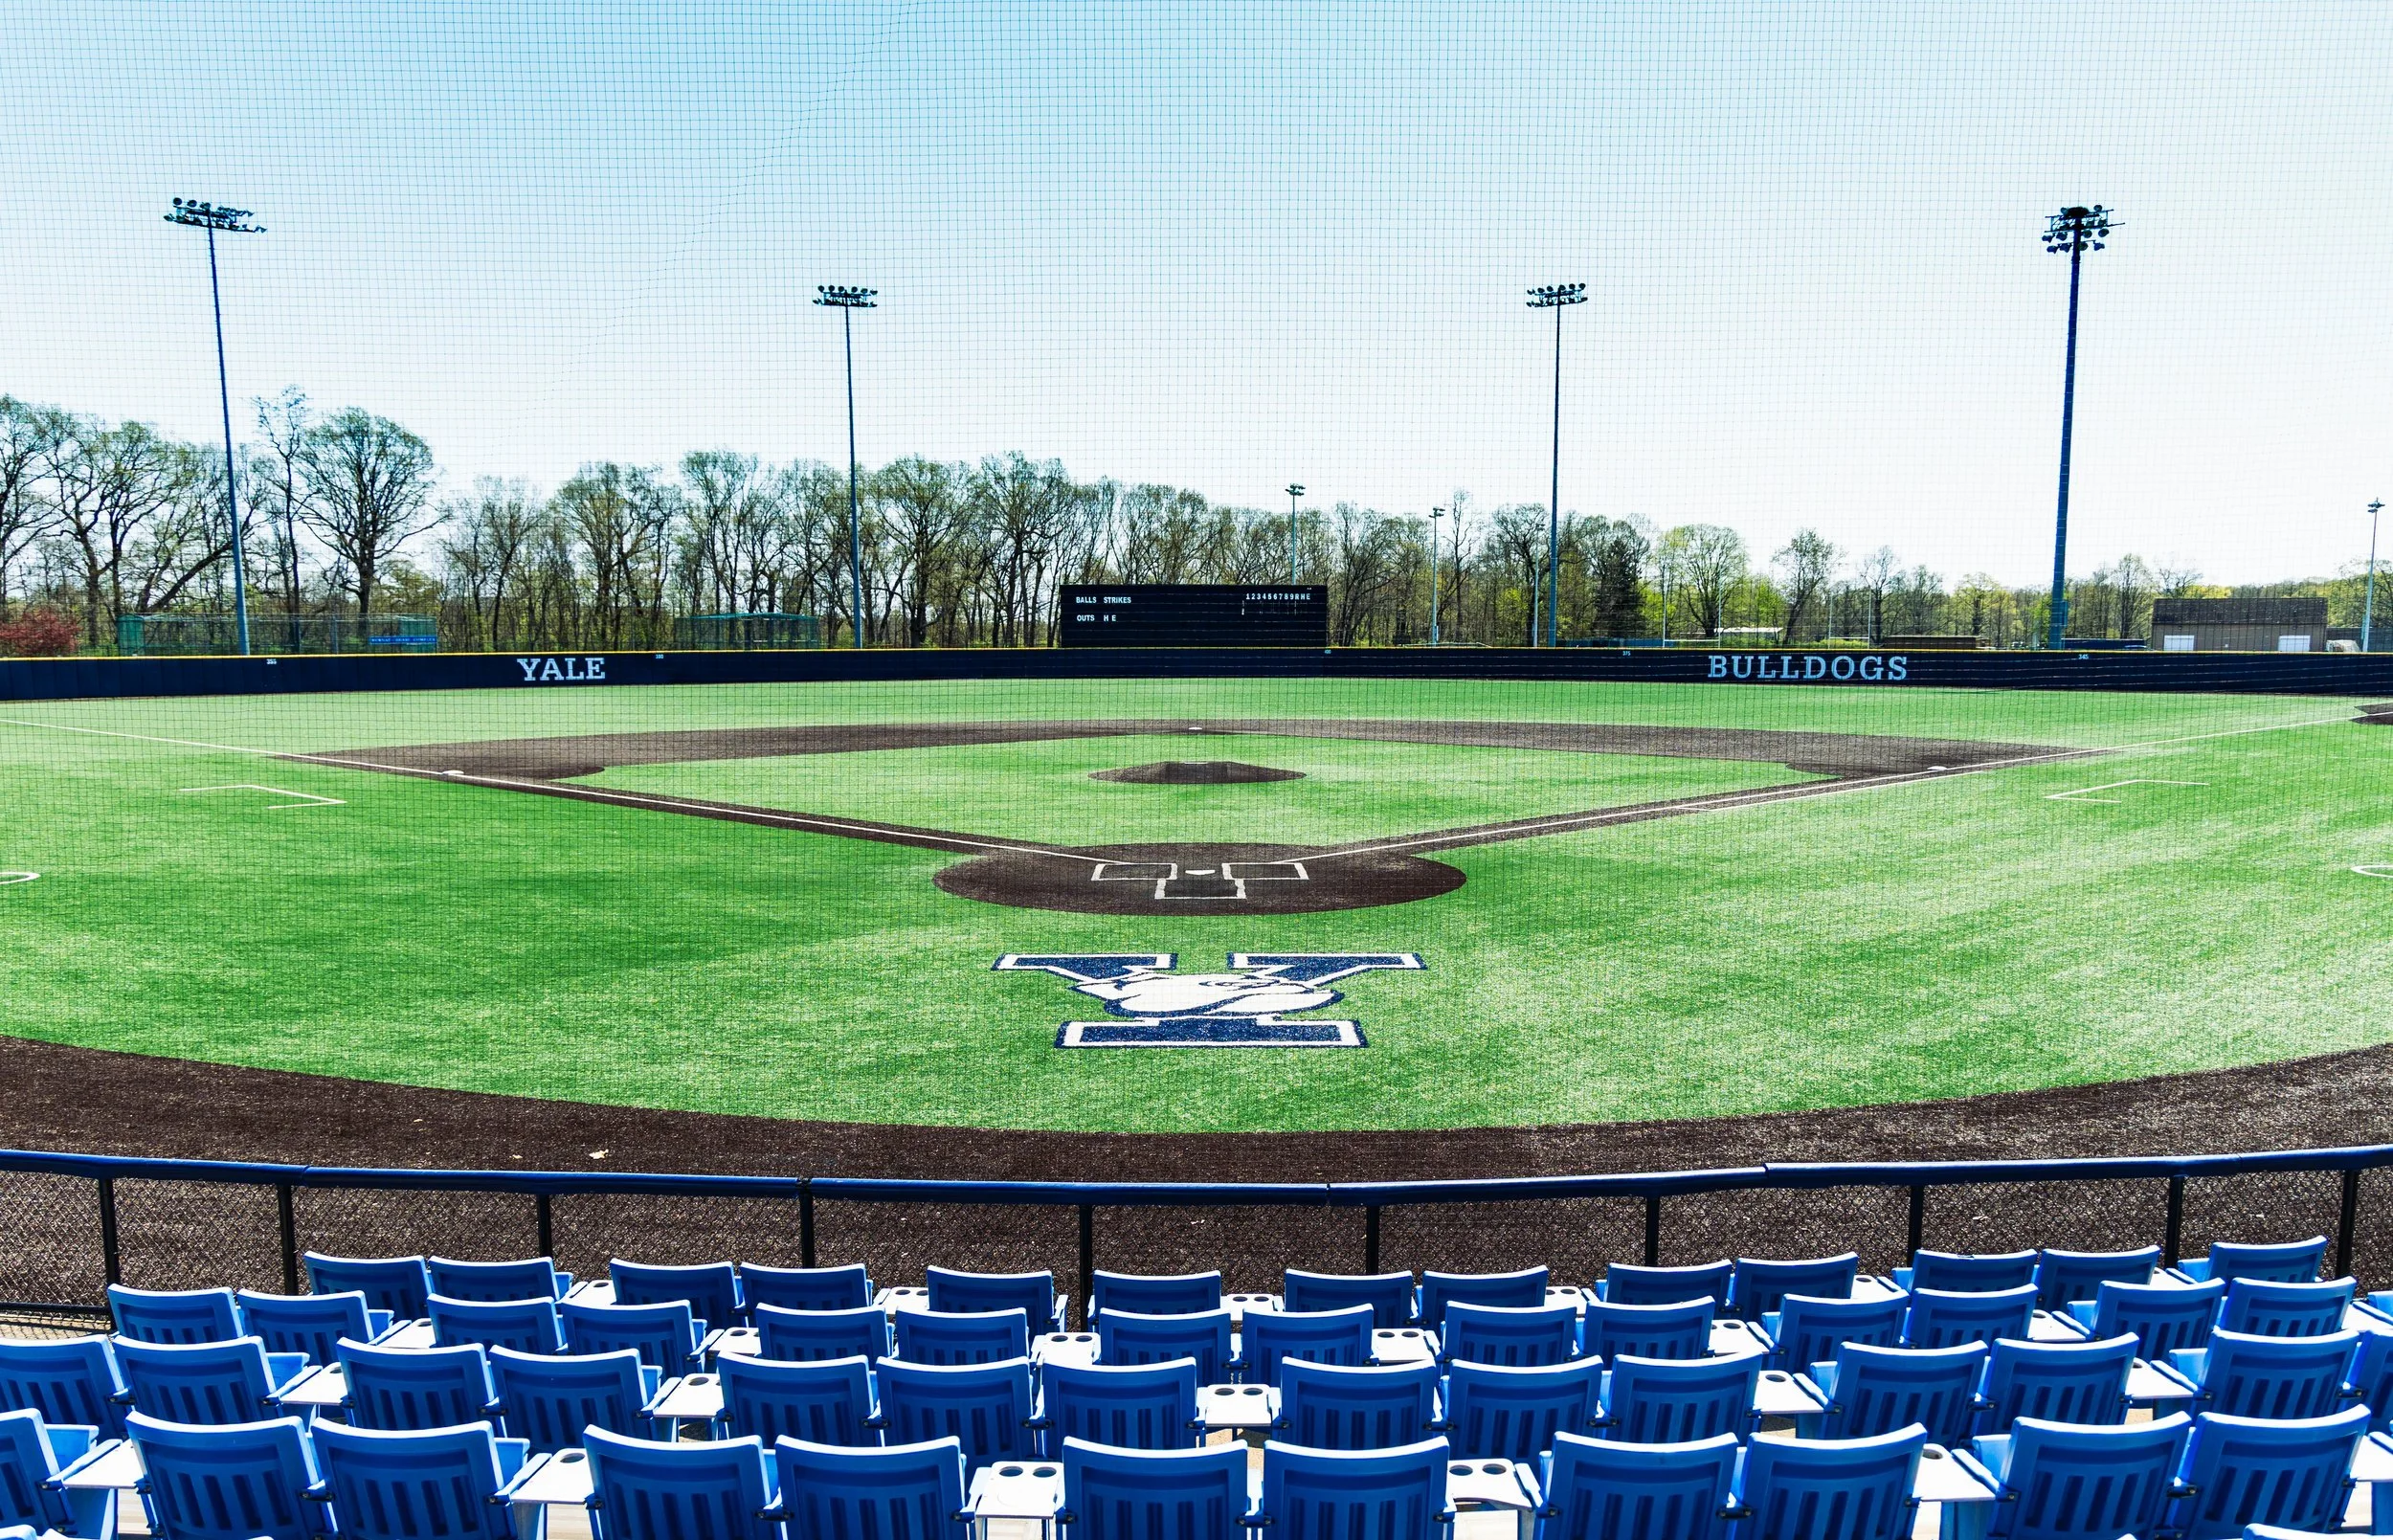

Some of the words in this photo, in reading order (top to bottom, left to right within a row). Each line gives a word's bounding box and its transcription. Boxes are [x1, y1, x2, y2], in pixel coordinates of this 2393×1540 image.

[517, 657, 606, 681] YALE
[1708, 655, 1908, 681] BULLDOGS
[992, 953, 1428, 1048] Y
